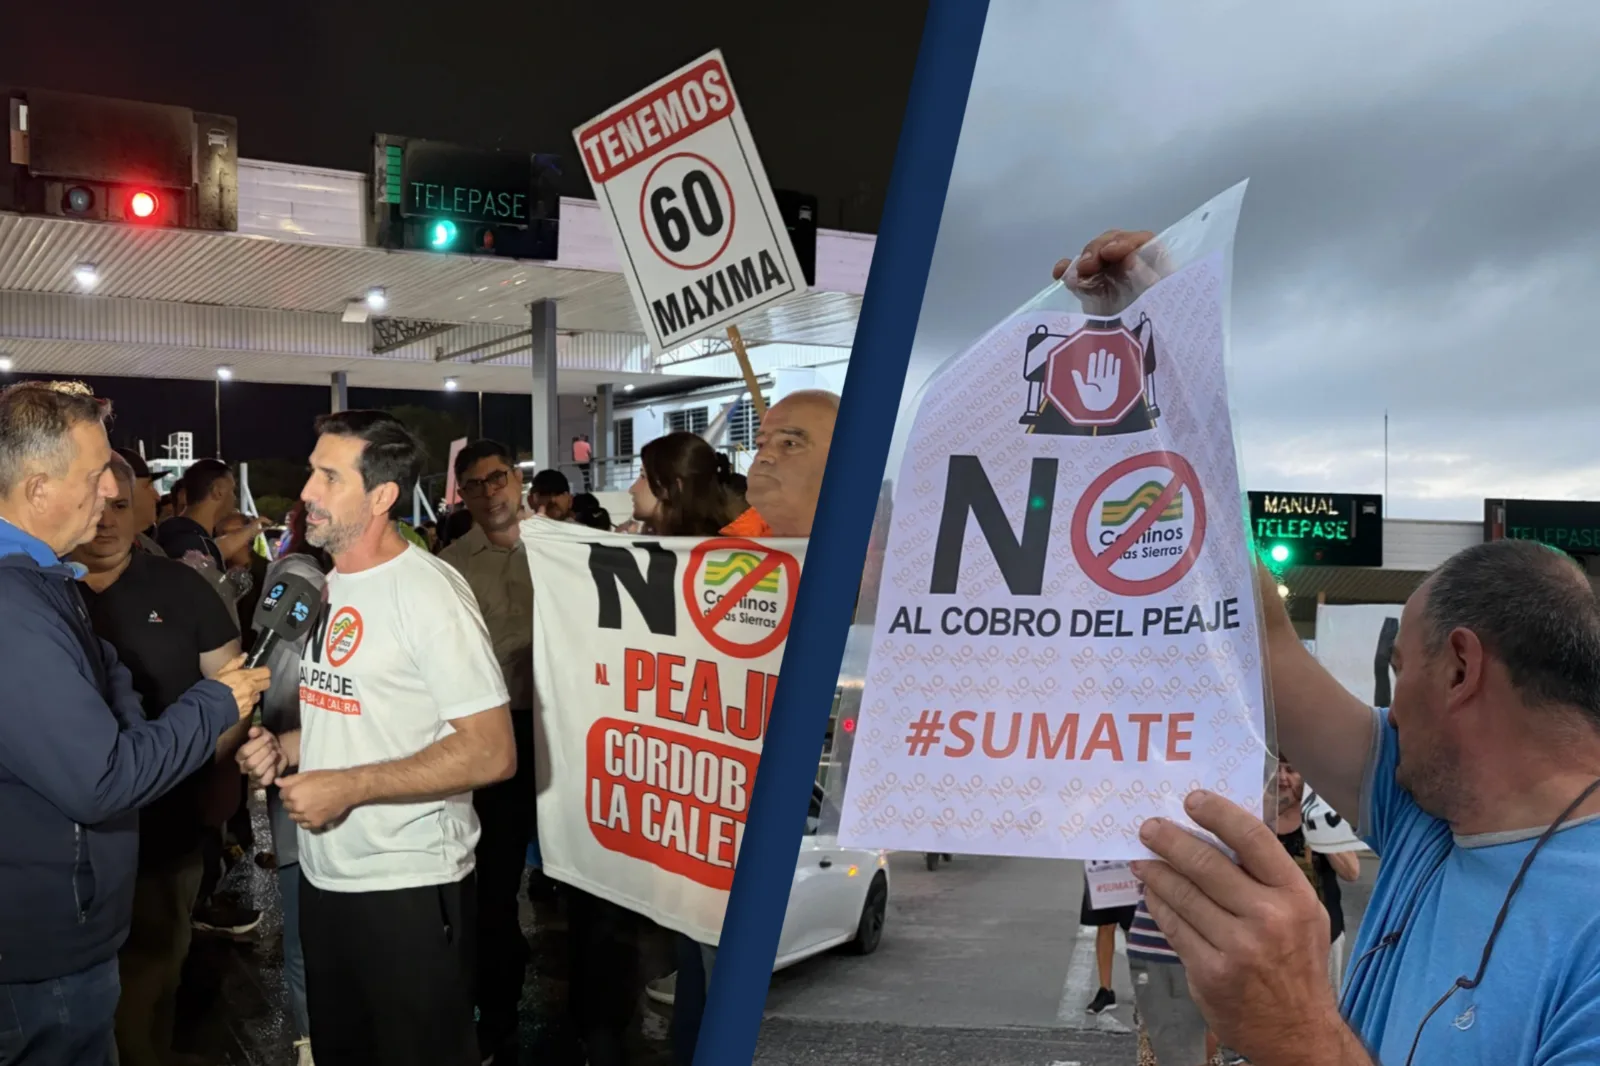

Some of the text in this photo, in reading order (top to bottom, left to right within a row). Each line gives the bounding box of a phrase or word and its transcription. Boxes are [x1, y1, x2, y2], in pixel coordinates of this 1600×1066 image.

[583, 69, 728, 176] TENEMOS
[411, 182, 526, 219] TELEPASE
[651, 170, 723, 252] 60
[652, 249, 785, 336] MAXIMA
[1264, 494, 1339, 515] MANUAL
[1100, 527, 1183, 546] Cinos
[1256, 518, 1349, 540] TELEPASE
[1141, 545, 1183, 559] Sierras
[722, 612, 736, 622] as
[739, 612, 777, 629] Sierras
[888, 597, 1240, 637] AL COBRO DEL PEAJE
[876, 639, 1231, 670] NO NO NO NO NO NO NO NO NO NO NO NO NO
[872, 667, 1236, 700] NO NO NO NO NO NO NO NO NO NO NO NO NO
[327, 697, 359, 713] CALRA
[906, 710, 1194, 762] #SUMATE
[592, 777, 630, 834] LA
[873, 772, 897, 795] NO
[901, 773, 926, 796] NO
[931, 773, 955, 797] NO
[960, 774, 983, 798] NO
[988, 776, 1013, 798] NO
[1015, 776, 1041, 800] NO
[1058, 777, 1082, 803] NO
[1088, 778, 1112, 806] NO
[1119, 779, 1144, 806] NO
[1148, 780, 1171, 806] NO
